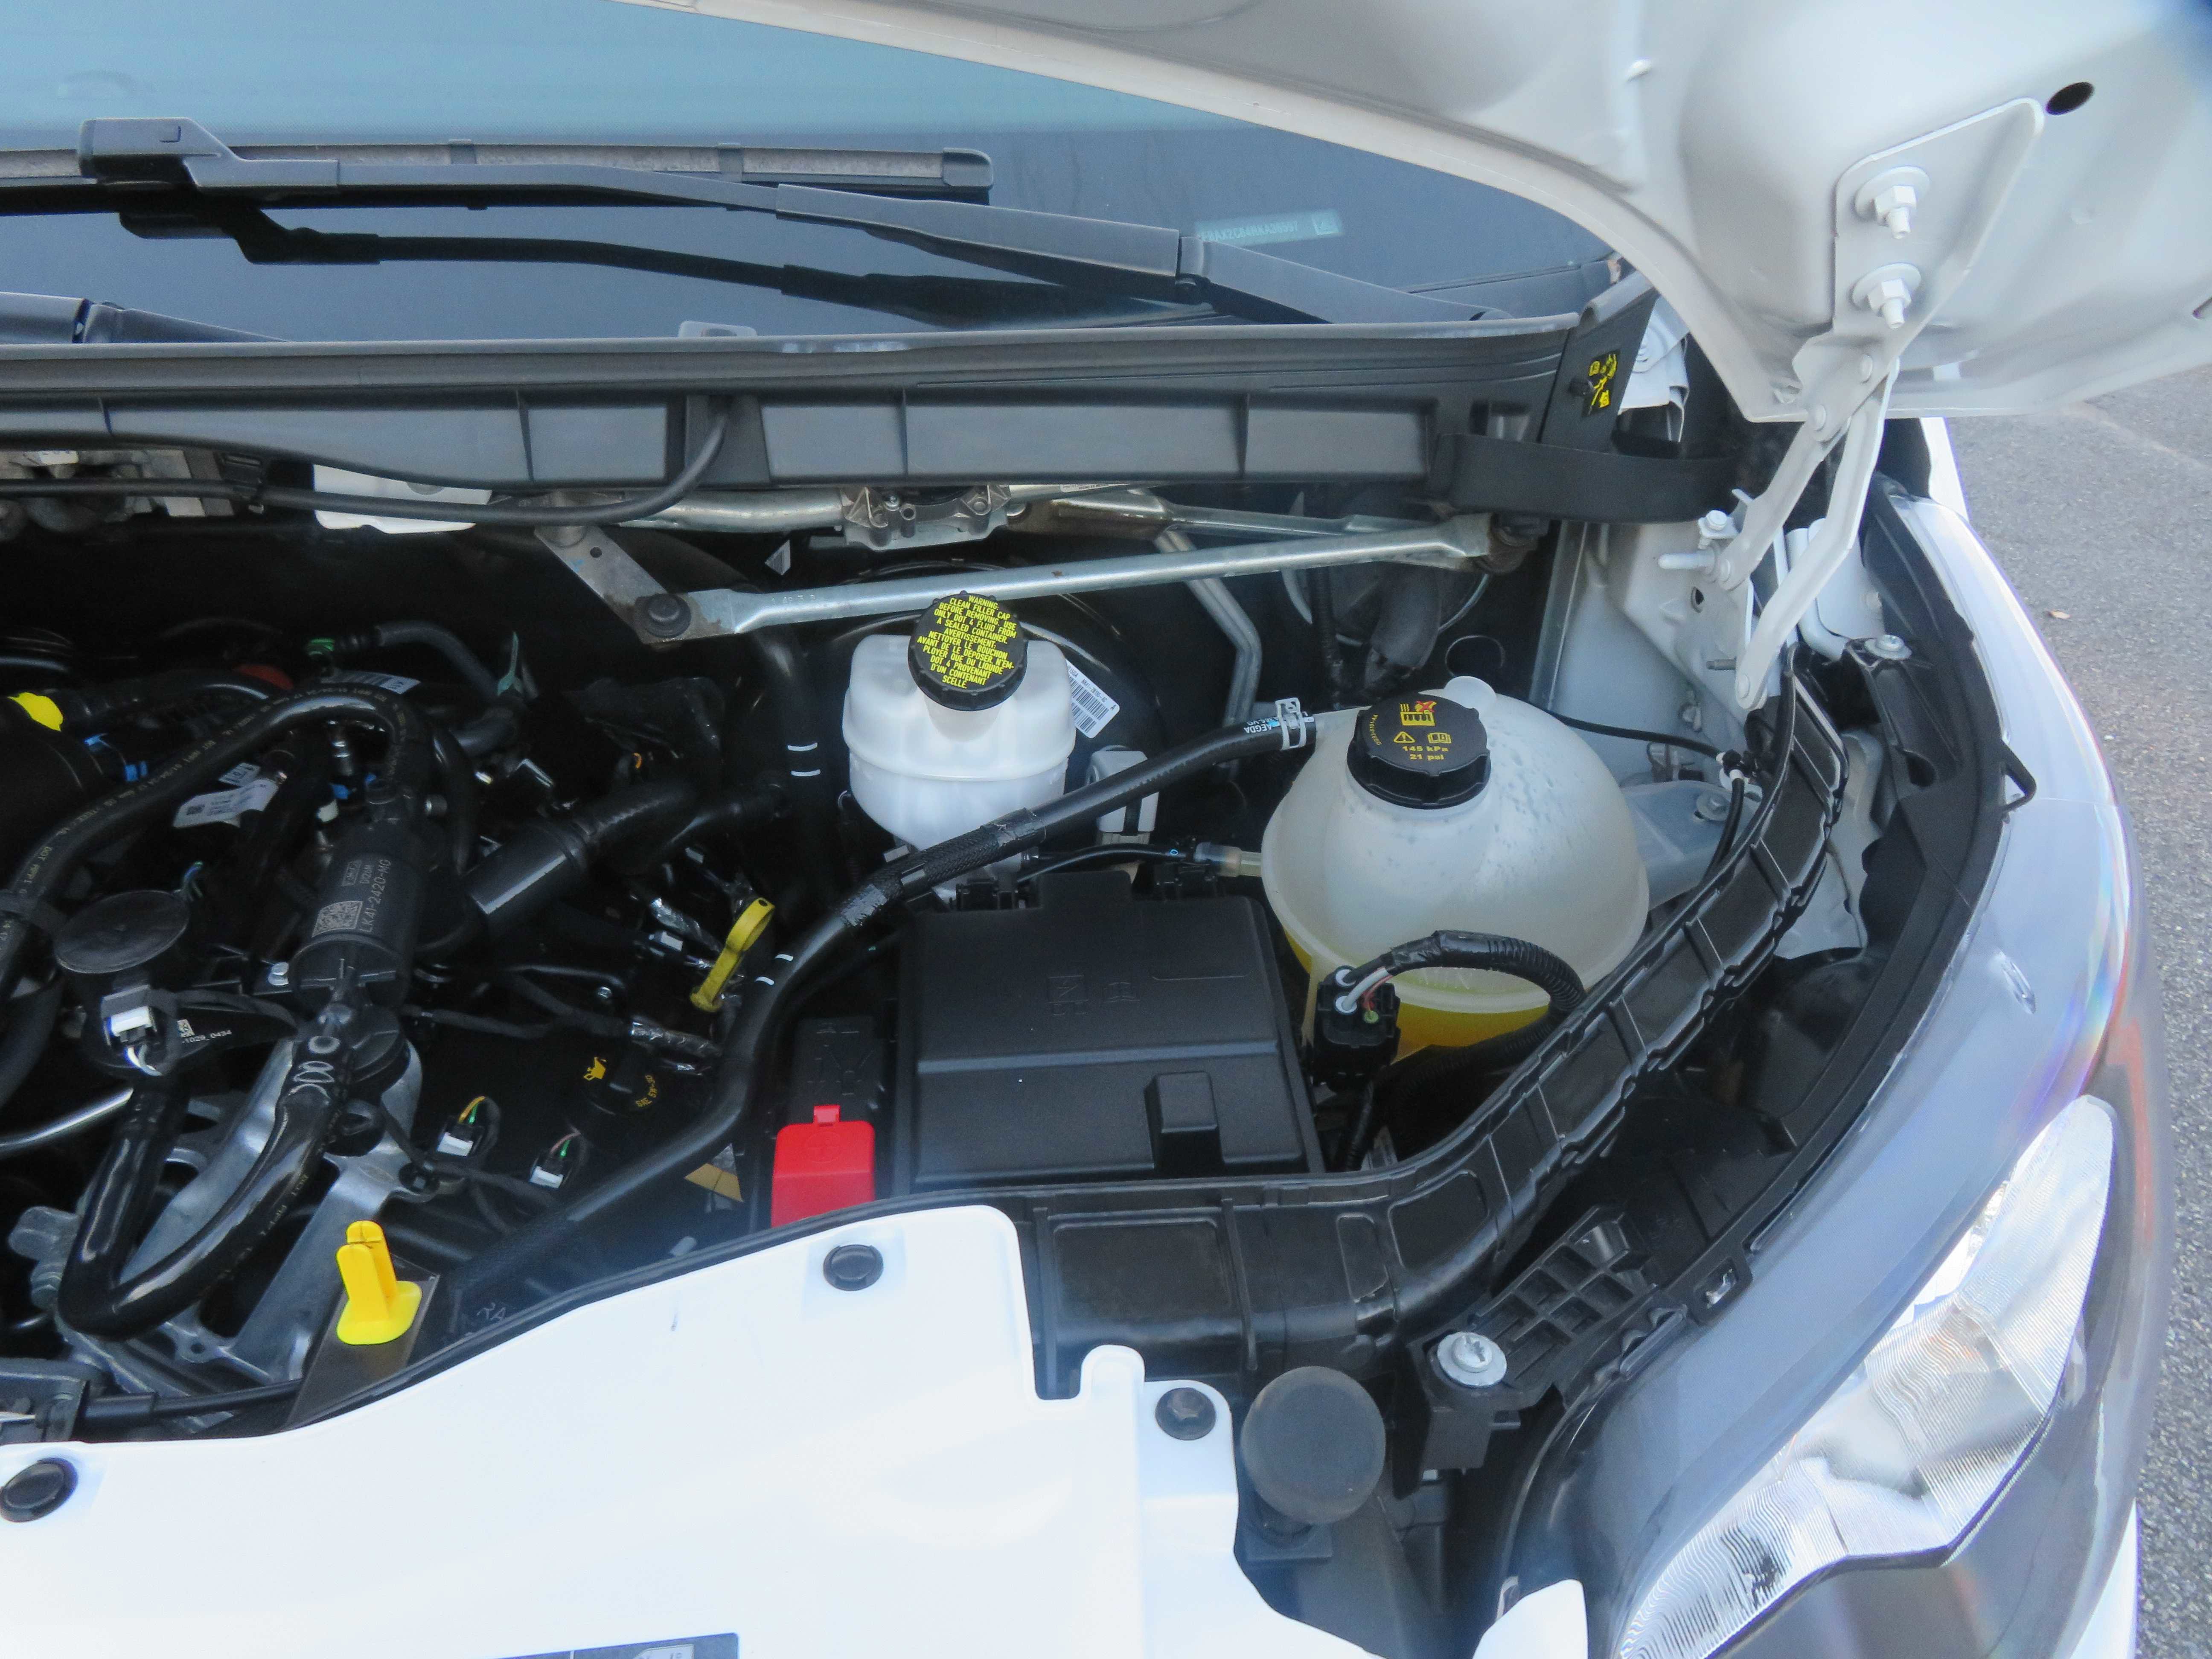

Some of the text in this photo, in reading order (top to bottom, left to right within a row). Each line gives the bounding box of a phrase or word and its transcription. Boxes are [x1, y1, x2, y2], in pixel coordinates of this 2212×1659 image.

[950, 598, 1010, 620] CLEAN FILLER CAP
[969, 595, 999, 610] WARNING:
[934, 608, 952, 619] ONLY
[954, 614, 967, 623] DOT
[976, 620, 995, 632] FLUID
[998, 627, 1017, 638] FROM
[939, 602, 1016, 631] BEFORE REMOVING. USE
[944, 628, 996, 649] AVERTISSEMENT:
[945, 620, 969, 632] SEALED
[972, 628, 1007, 644] CONTAINER.
[917, 636, 939, 647] AVANT
[941, 642, 950, 651] DE
[952, 646, 961, 654] LE
[928, 631, 1008, 660] NETTOYER LE BOUCHON
[923, 645, 1004, 675] PLOYER QUE DU LIQUIDE
[930, 655, 944, 665] DOT
[953, 662, 992, 679] PROVENANT
[949, 669, 987, 685] CONTENANT
[635, 1097, 652, 1107] SAE
